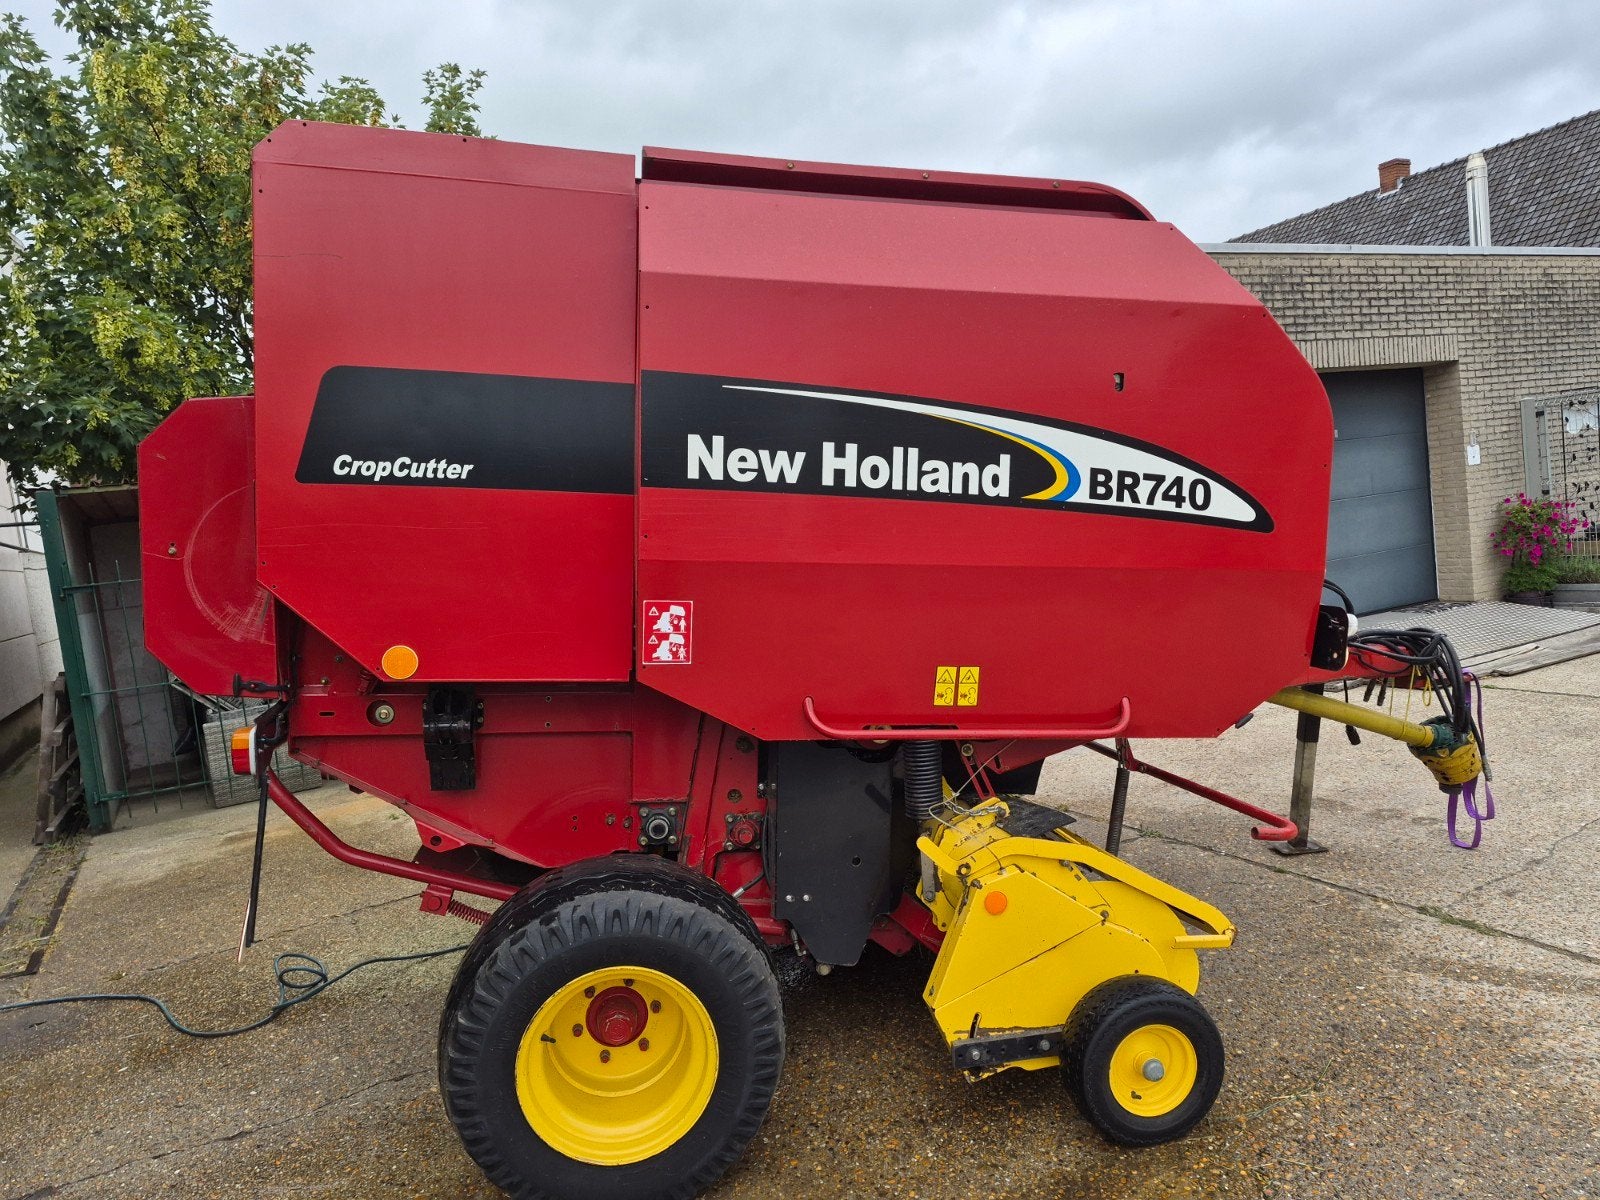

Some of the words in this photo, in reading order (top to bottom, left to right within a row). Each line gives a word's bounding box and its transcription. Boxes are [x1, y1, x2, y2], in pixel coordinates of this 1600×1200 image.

[334, 454, 474, 481] CropCutter
[687, 434, 806, 484] New
[822, 442, 1010, 498] Holland
[1089, 468, 1212, 512] BR740
